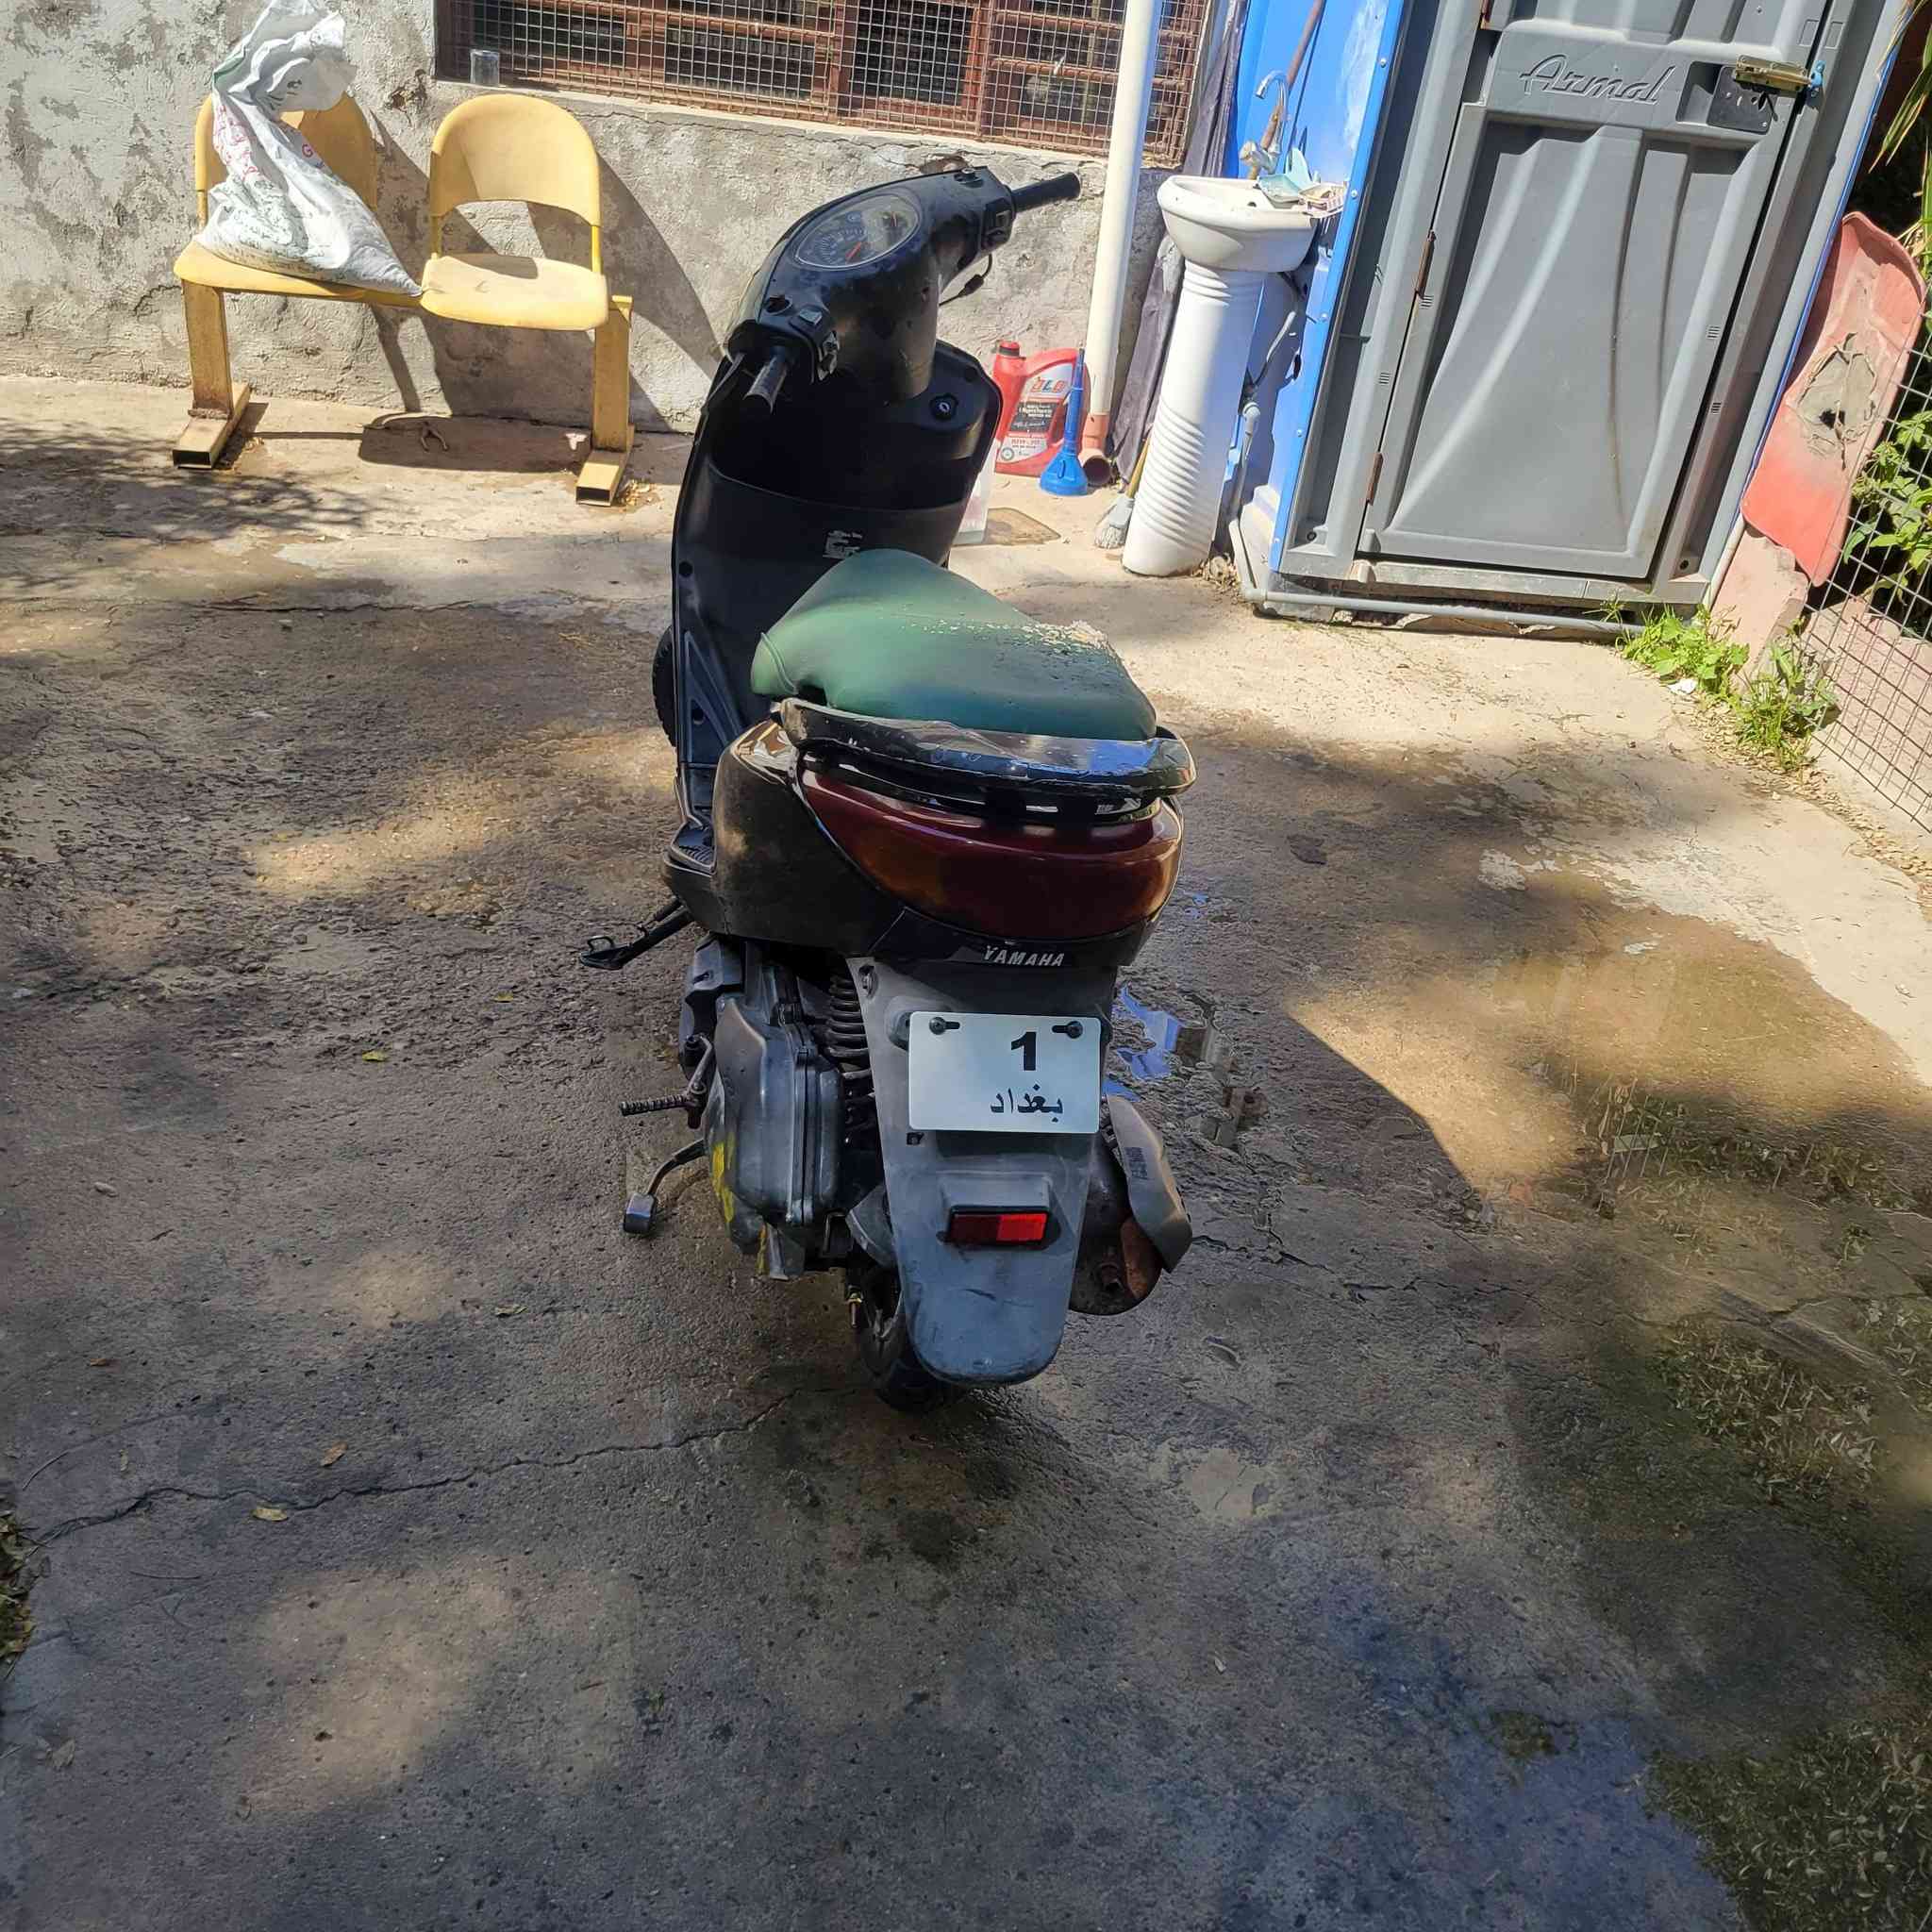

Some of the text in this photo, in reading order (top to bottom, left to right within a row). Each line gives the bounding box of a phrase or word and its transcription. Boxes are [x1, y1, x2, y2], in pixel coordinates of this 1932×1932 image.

[984, 944, 1065, 966] YAMAHA
[1010, 1031, 1037, 1072] 1
[990, 1083, 1063, 1123] بغداد
